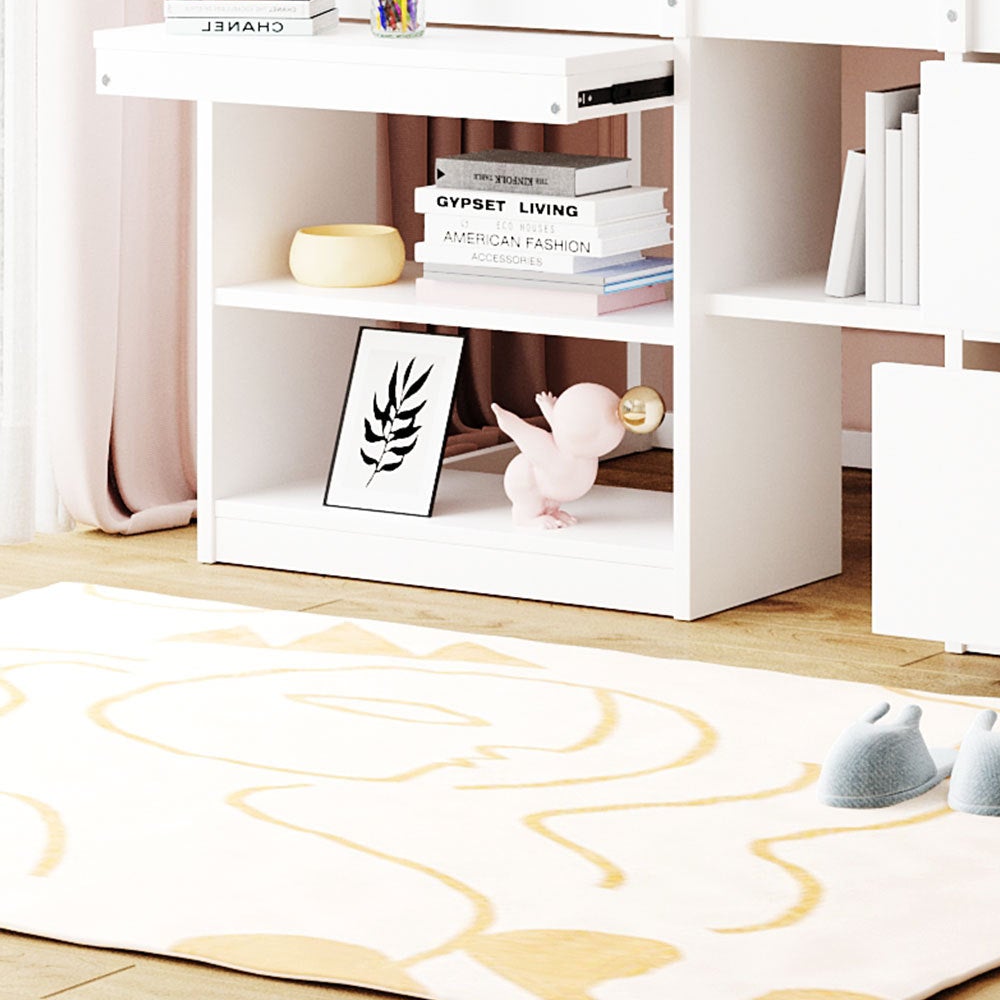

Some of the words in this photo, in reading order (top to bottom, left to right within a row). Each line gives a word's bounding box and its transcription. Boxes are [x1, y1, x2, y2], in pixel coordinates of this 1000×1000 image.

[494, 174, 533, 187] KINFOLK
[436, 195, 506, 212] GYPSET
[519, 202, 579, 217] LIVING
[496, 220, 513, 231] ECO
[443, 230, 521, 248] AMERICAN
[526, 237, 591, 253] FASHION
[471, 252, 543, 267] ACCESSORIES
